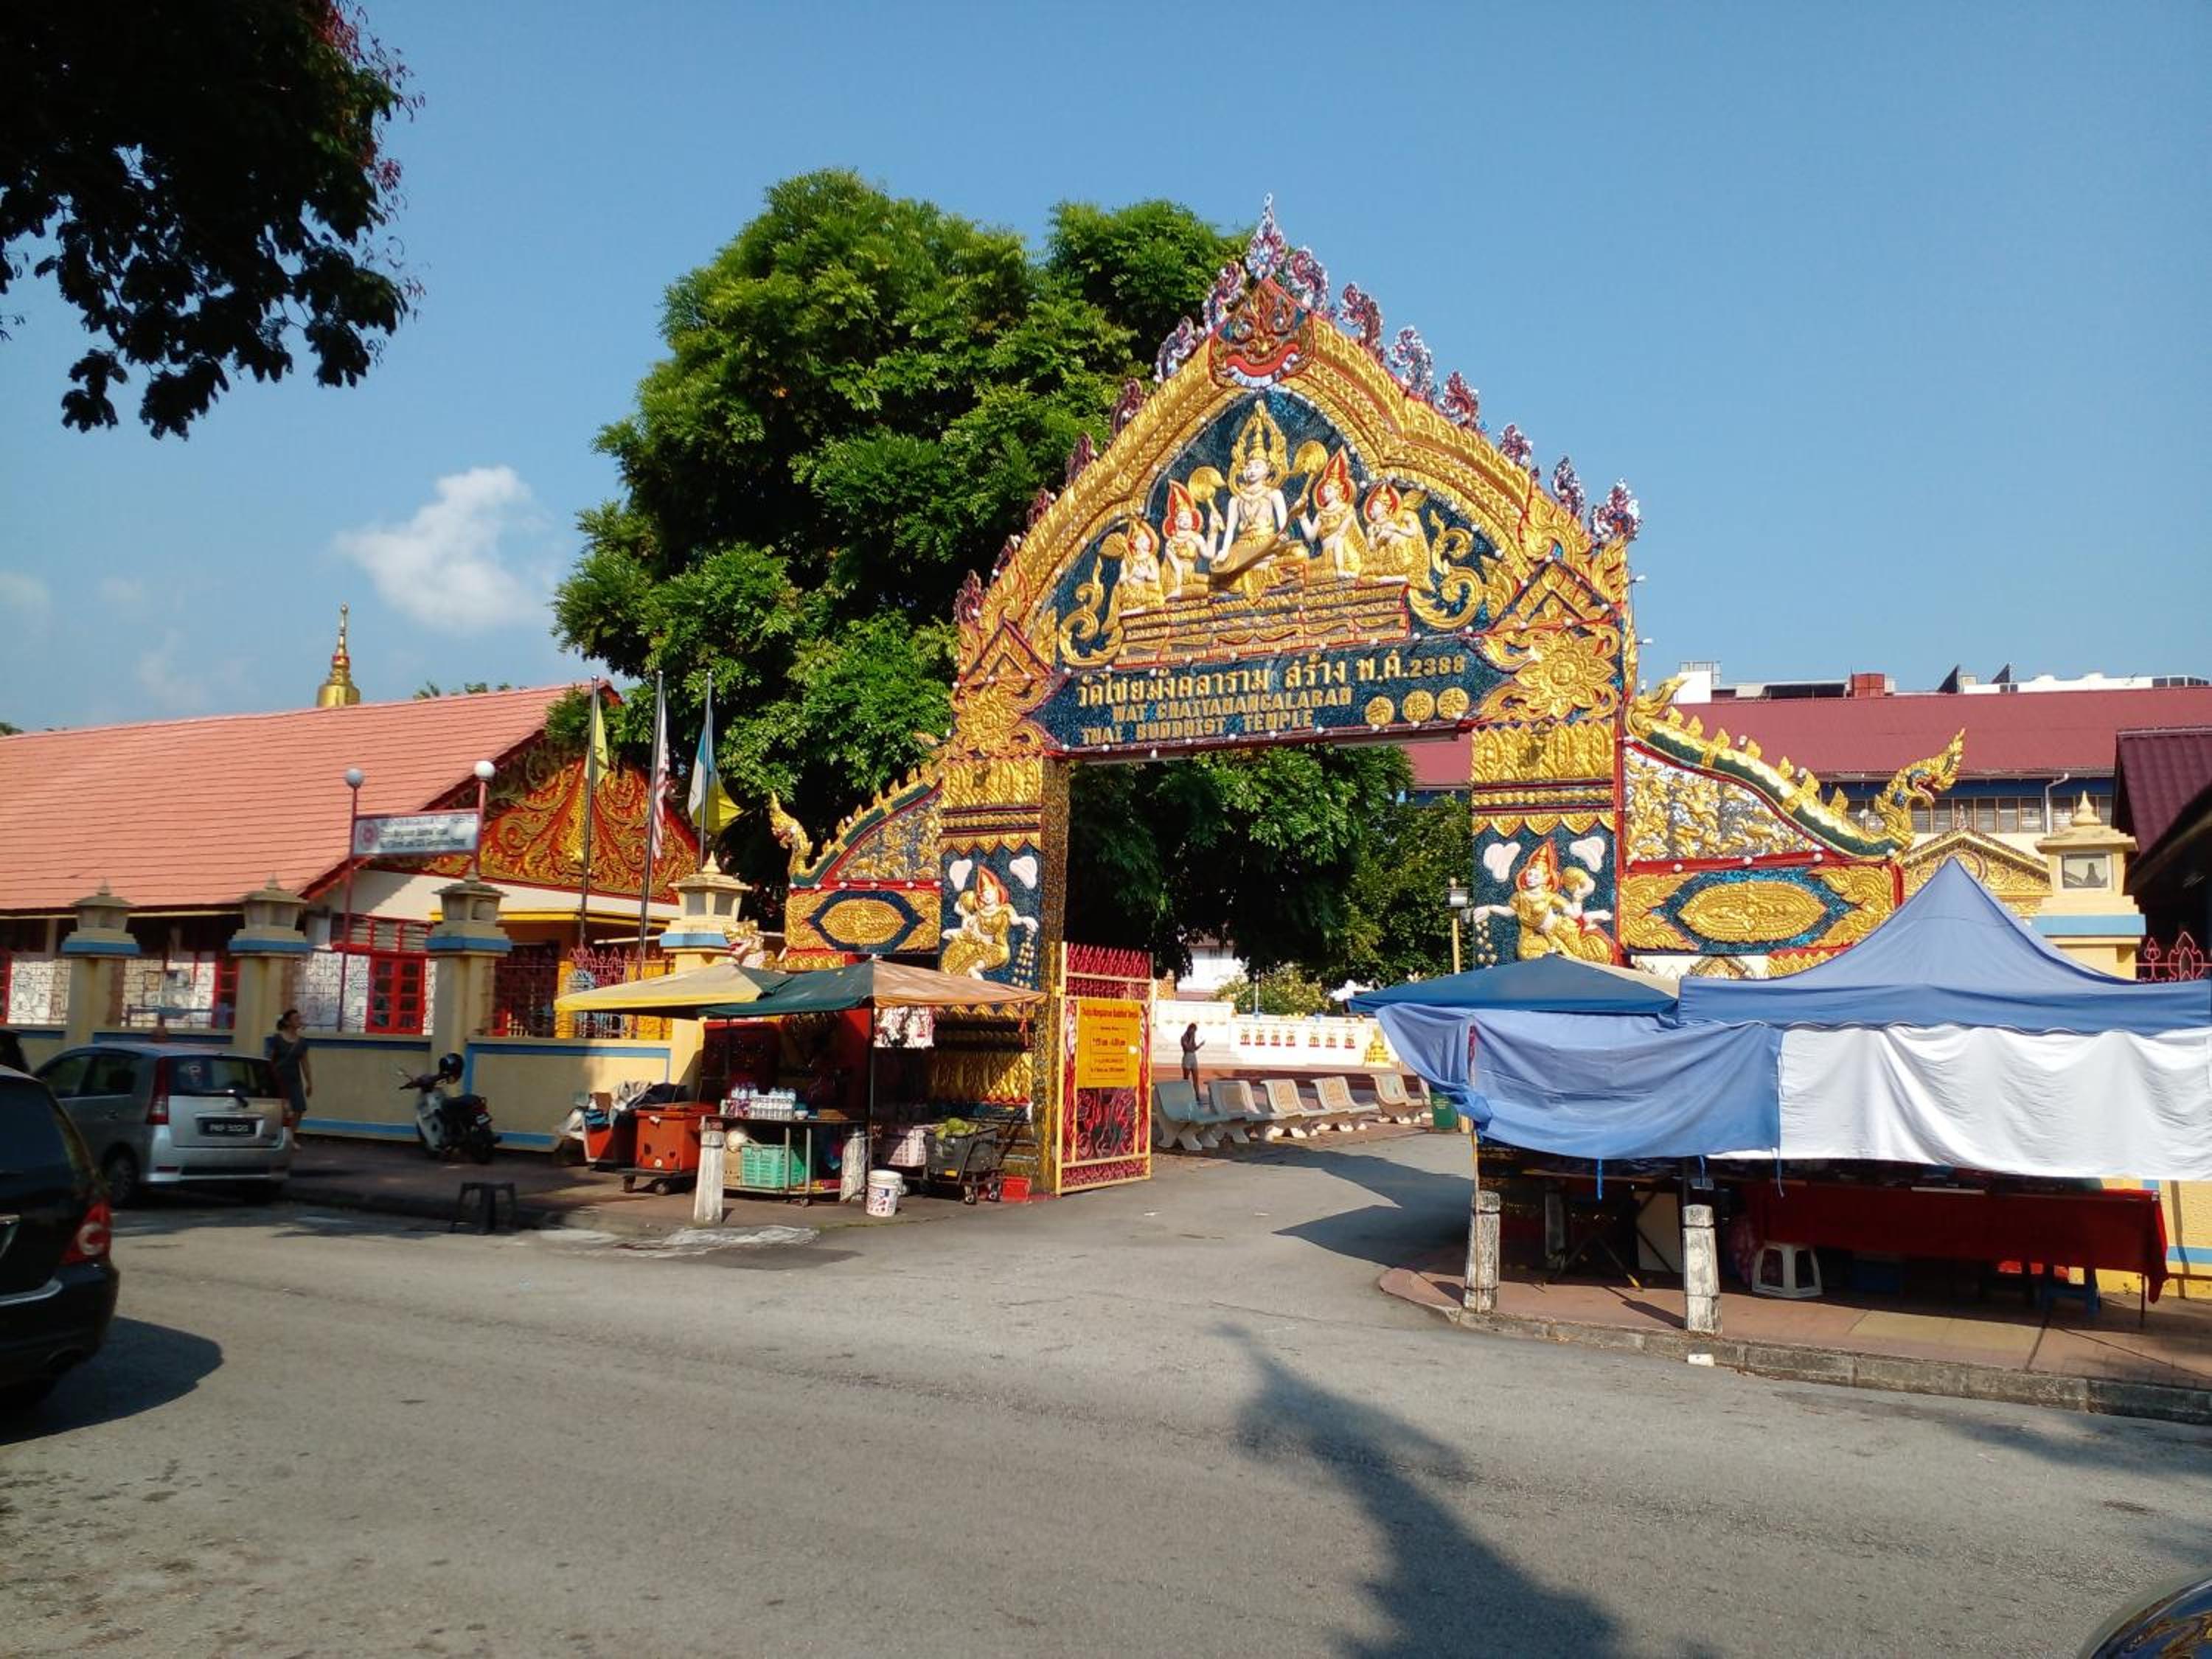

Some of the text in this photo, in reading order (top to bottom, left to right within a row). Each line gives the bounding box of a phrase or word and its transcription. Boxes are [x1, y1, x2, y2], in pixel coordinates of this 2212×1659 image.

[1112, 686, 1352, 723] WAT CHAIYAMANGALARAM
[1082, 709, 1314, 745] THAI BUDDHIST TEMPLE
